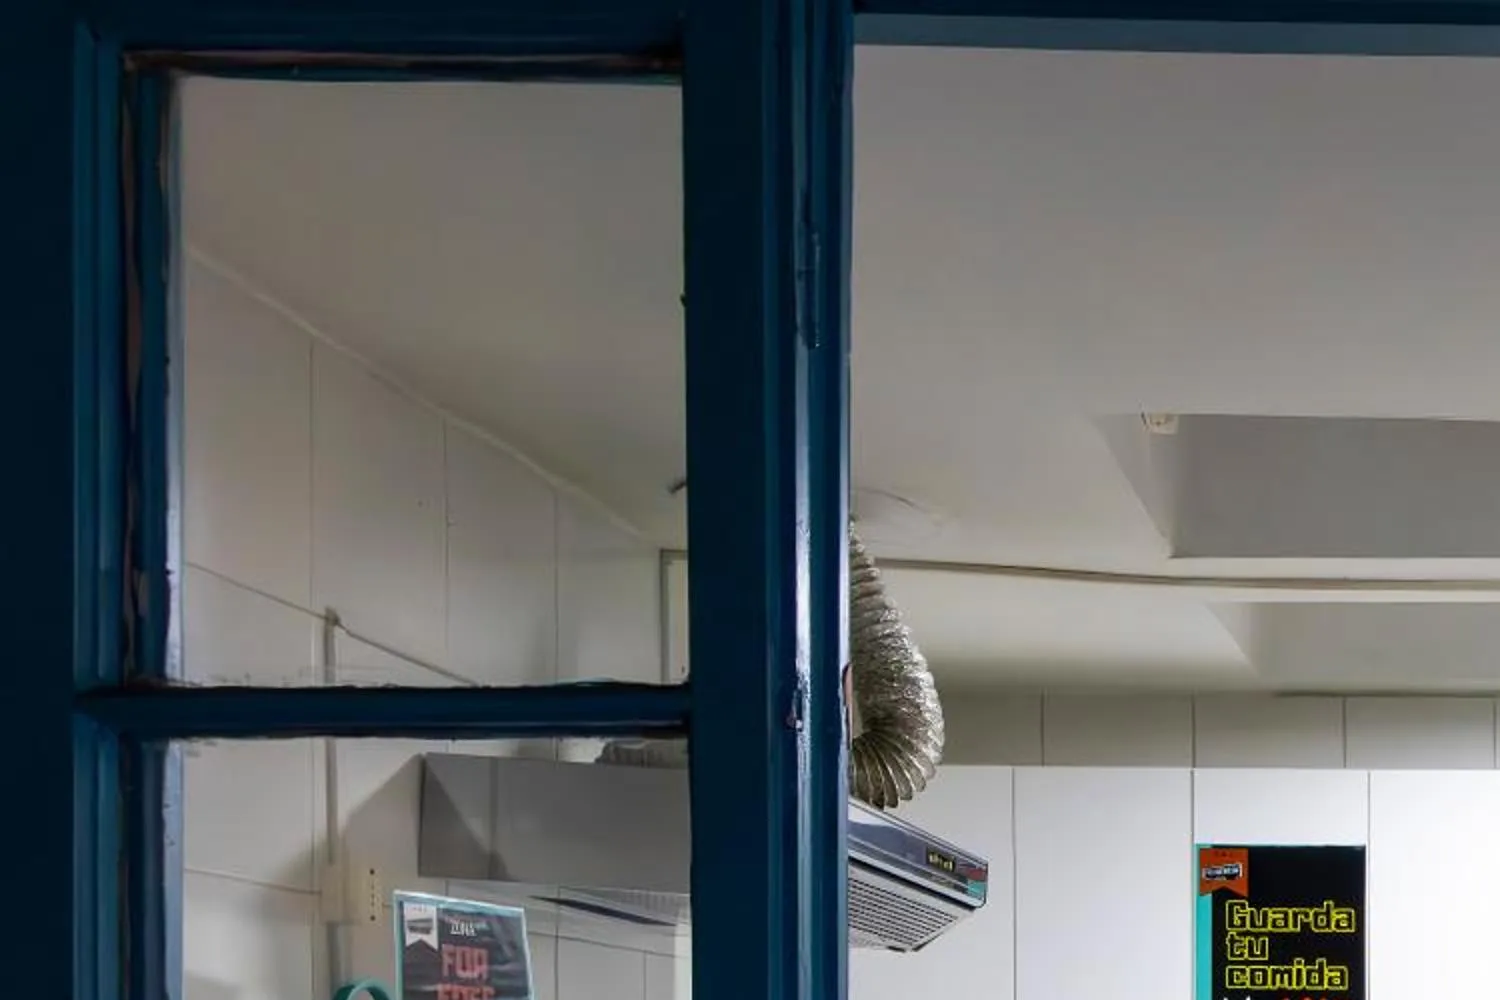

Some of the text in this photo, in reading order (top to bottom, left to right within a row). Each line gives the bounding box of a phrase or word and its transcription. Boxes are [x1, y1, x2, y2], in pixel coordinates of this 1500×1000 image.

[1225, 899, 1355, 932] Guarda
[441, 942, 490, 981] FOR
[1225, 931, 1269, 961] tu
[1225, 957, 1349, 990] comida
